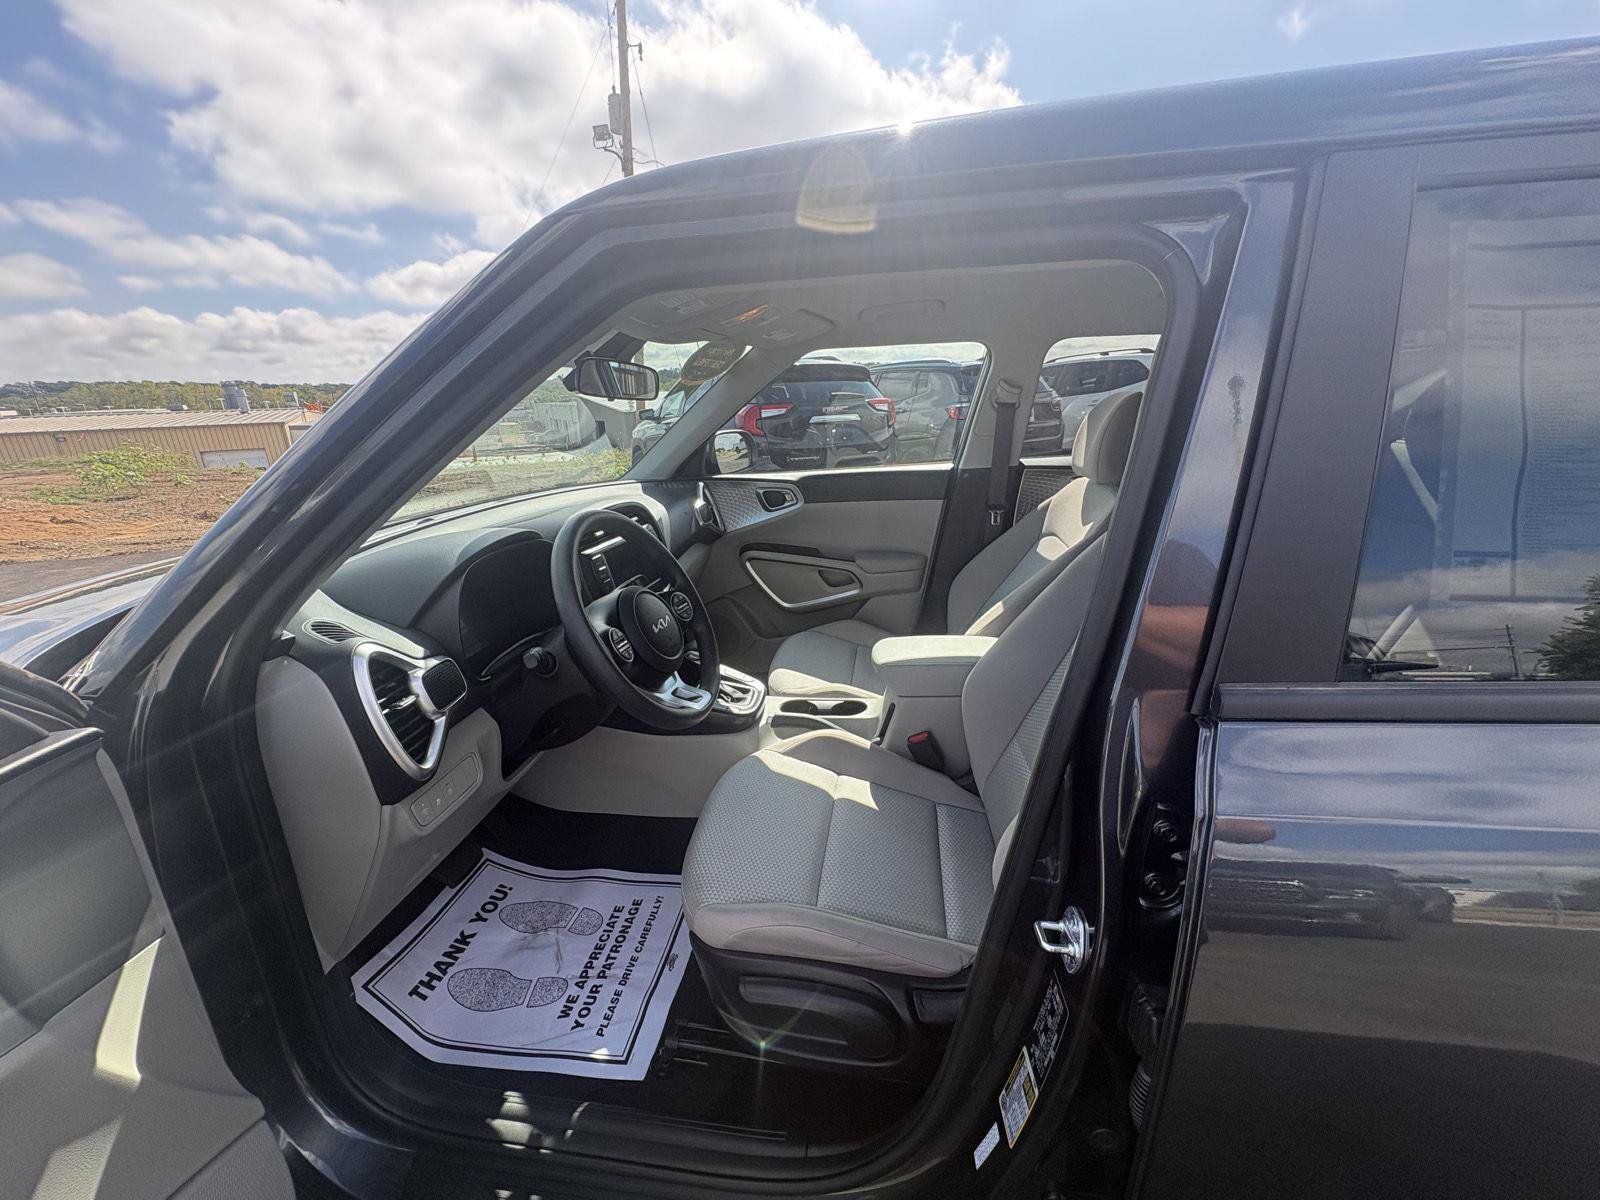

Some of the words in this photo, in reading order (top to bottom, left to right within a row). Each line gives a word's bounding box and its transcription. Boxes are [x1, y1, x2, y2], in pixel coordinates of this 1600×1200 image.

[408, 929, 478, 1001] THANK
[468, 884, 513, 924] YOU!
[557, 994, 580, 1019] WE
[575, 905, 625, 990] APPRECIATE
[570, 984, 603, 1031] YOUR
[596, 898, 643, 979] PATRONAGE
[596, 989, 623, 1037] PLEASE
[618, 956, 639, 987] DRIVE
[634, 895, 664, 953] CAREFULLY!
